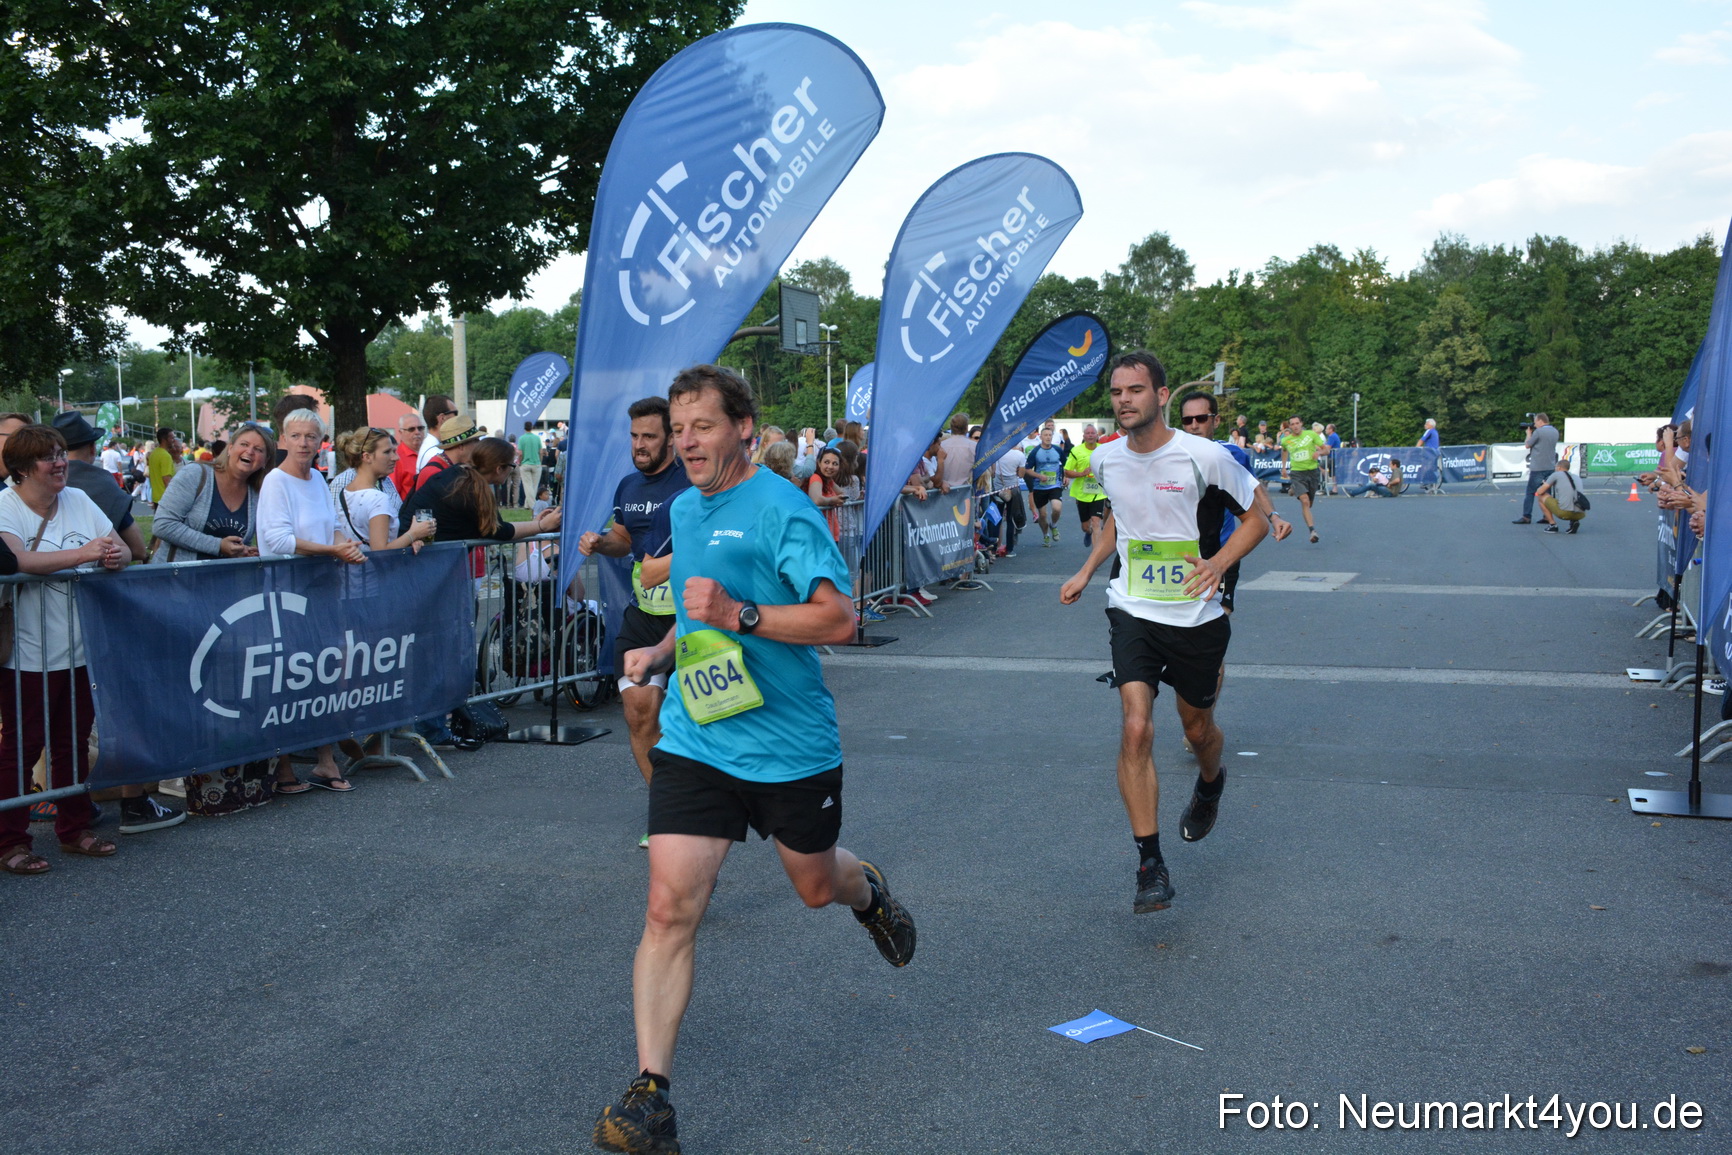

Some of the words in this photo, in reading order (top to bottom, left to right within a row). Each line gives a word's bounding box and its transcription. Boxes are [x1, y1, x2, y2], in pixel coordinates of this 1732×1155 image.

[656, 76, 819, 290] Fischer
[713, 118, 837, 288] AUTOMOBILE
[926, 185, 1036, 338] Fischer
[965, 213, 1050, 335] AUTOMOBILE
[521, 362, 557, 409] Fischer
[1000, 358, 1078, 423] Frischmann
[1592, 450, 1617, 464] AOK
[624, 503, 645, 512] EURO
[907, 518, 959, 547] Frischmann
[1141, 564, 1185, 585] 415
[241, 629, 416, 699] Fischer
[683, 658, 744, 700] 1064
[260, 679, 405, 729] AUTOMOBILE
